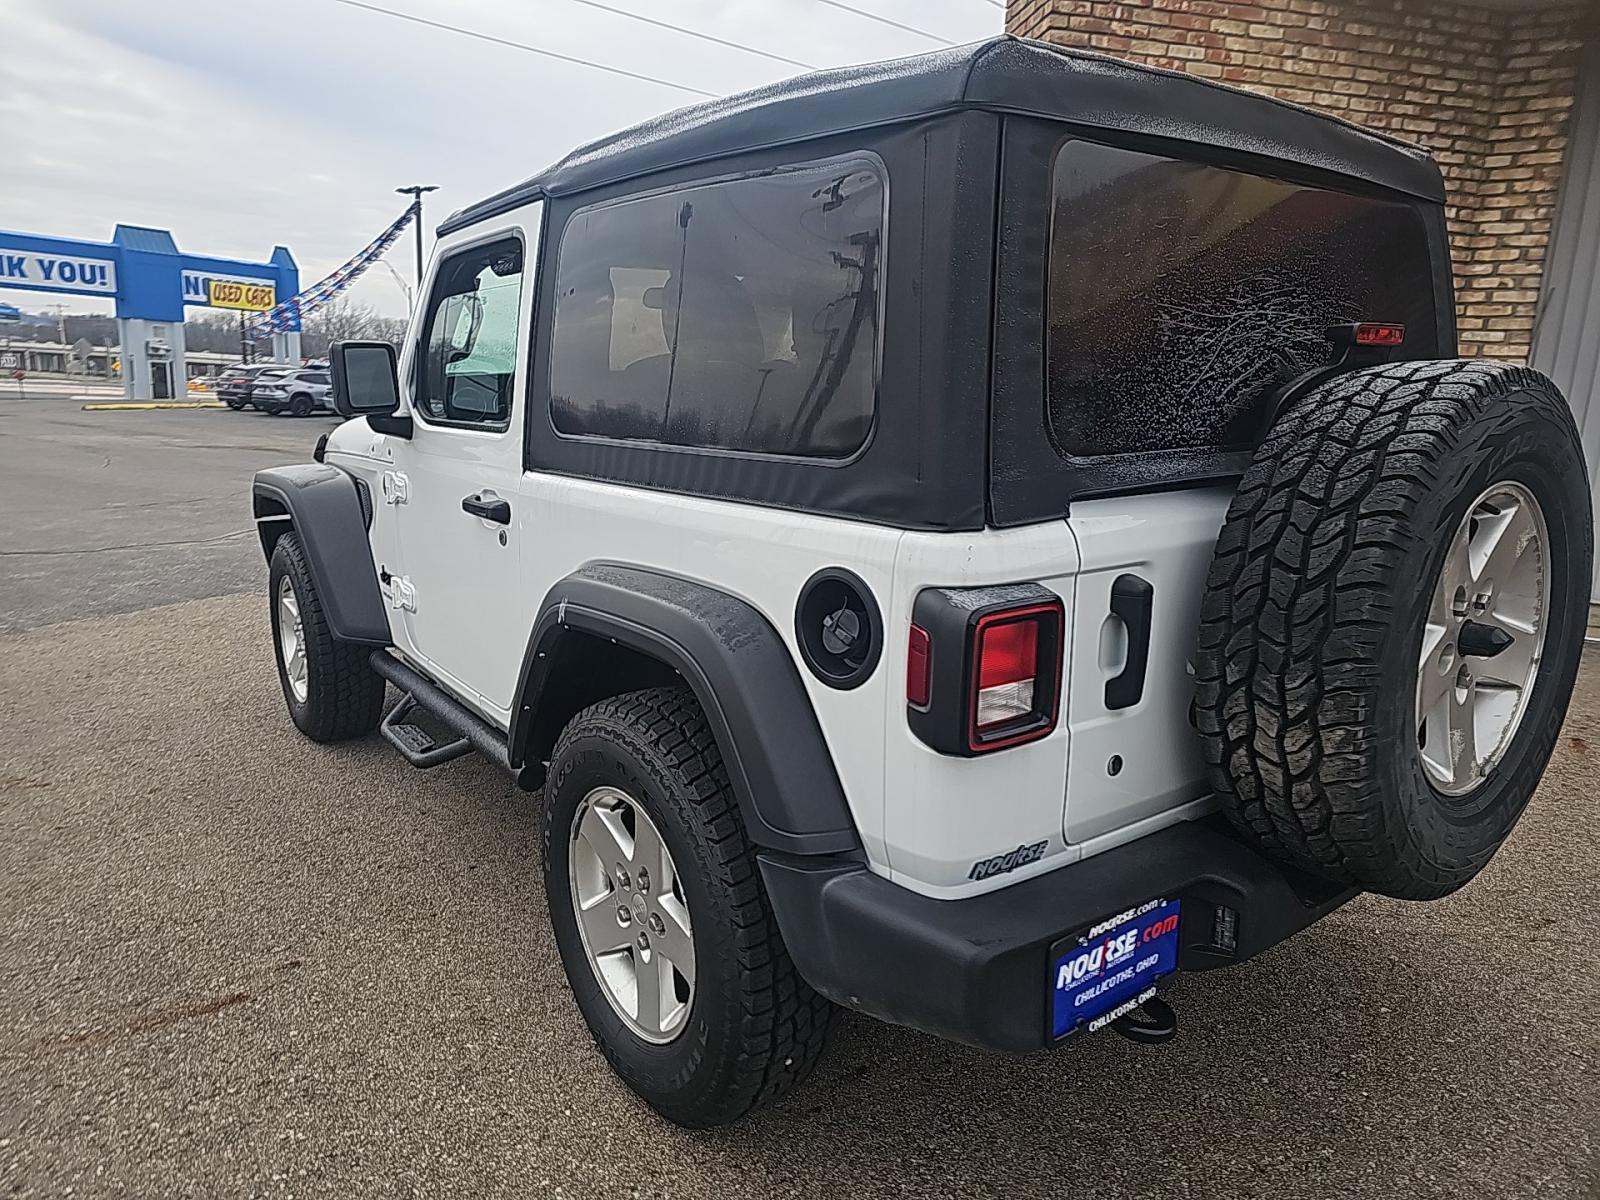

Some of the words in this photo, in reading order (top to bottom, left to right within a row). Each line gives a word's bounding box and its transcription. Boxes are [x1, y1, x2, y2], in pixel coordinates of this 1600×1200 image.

[35, 258, 108, 286] YOU!
[213, 283, 243, 303] USED
[246, 286, 273, 307] CARS
[967, 839, 1049, 881] NOURSE
[1088, 899, 1158, 939] NOURSE.com
[1135, 953, 1159, 973] OHIO
[1137, 986, 1157, 1004] OHIO
